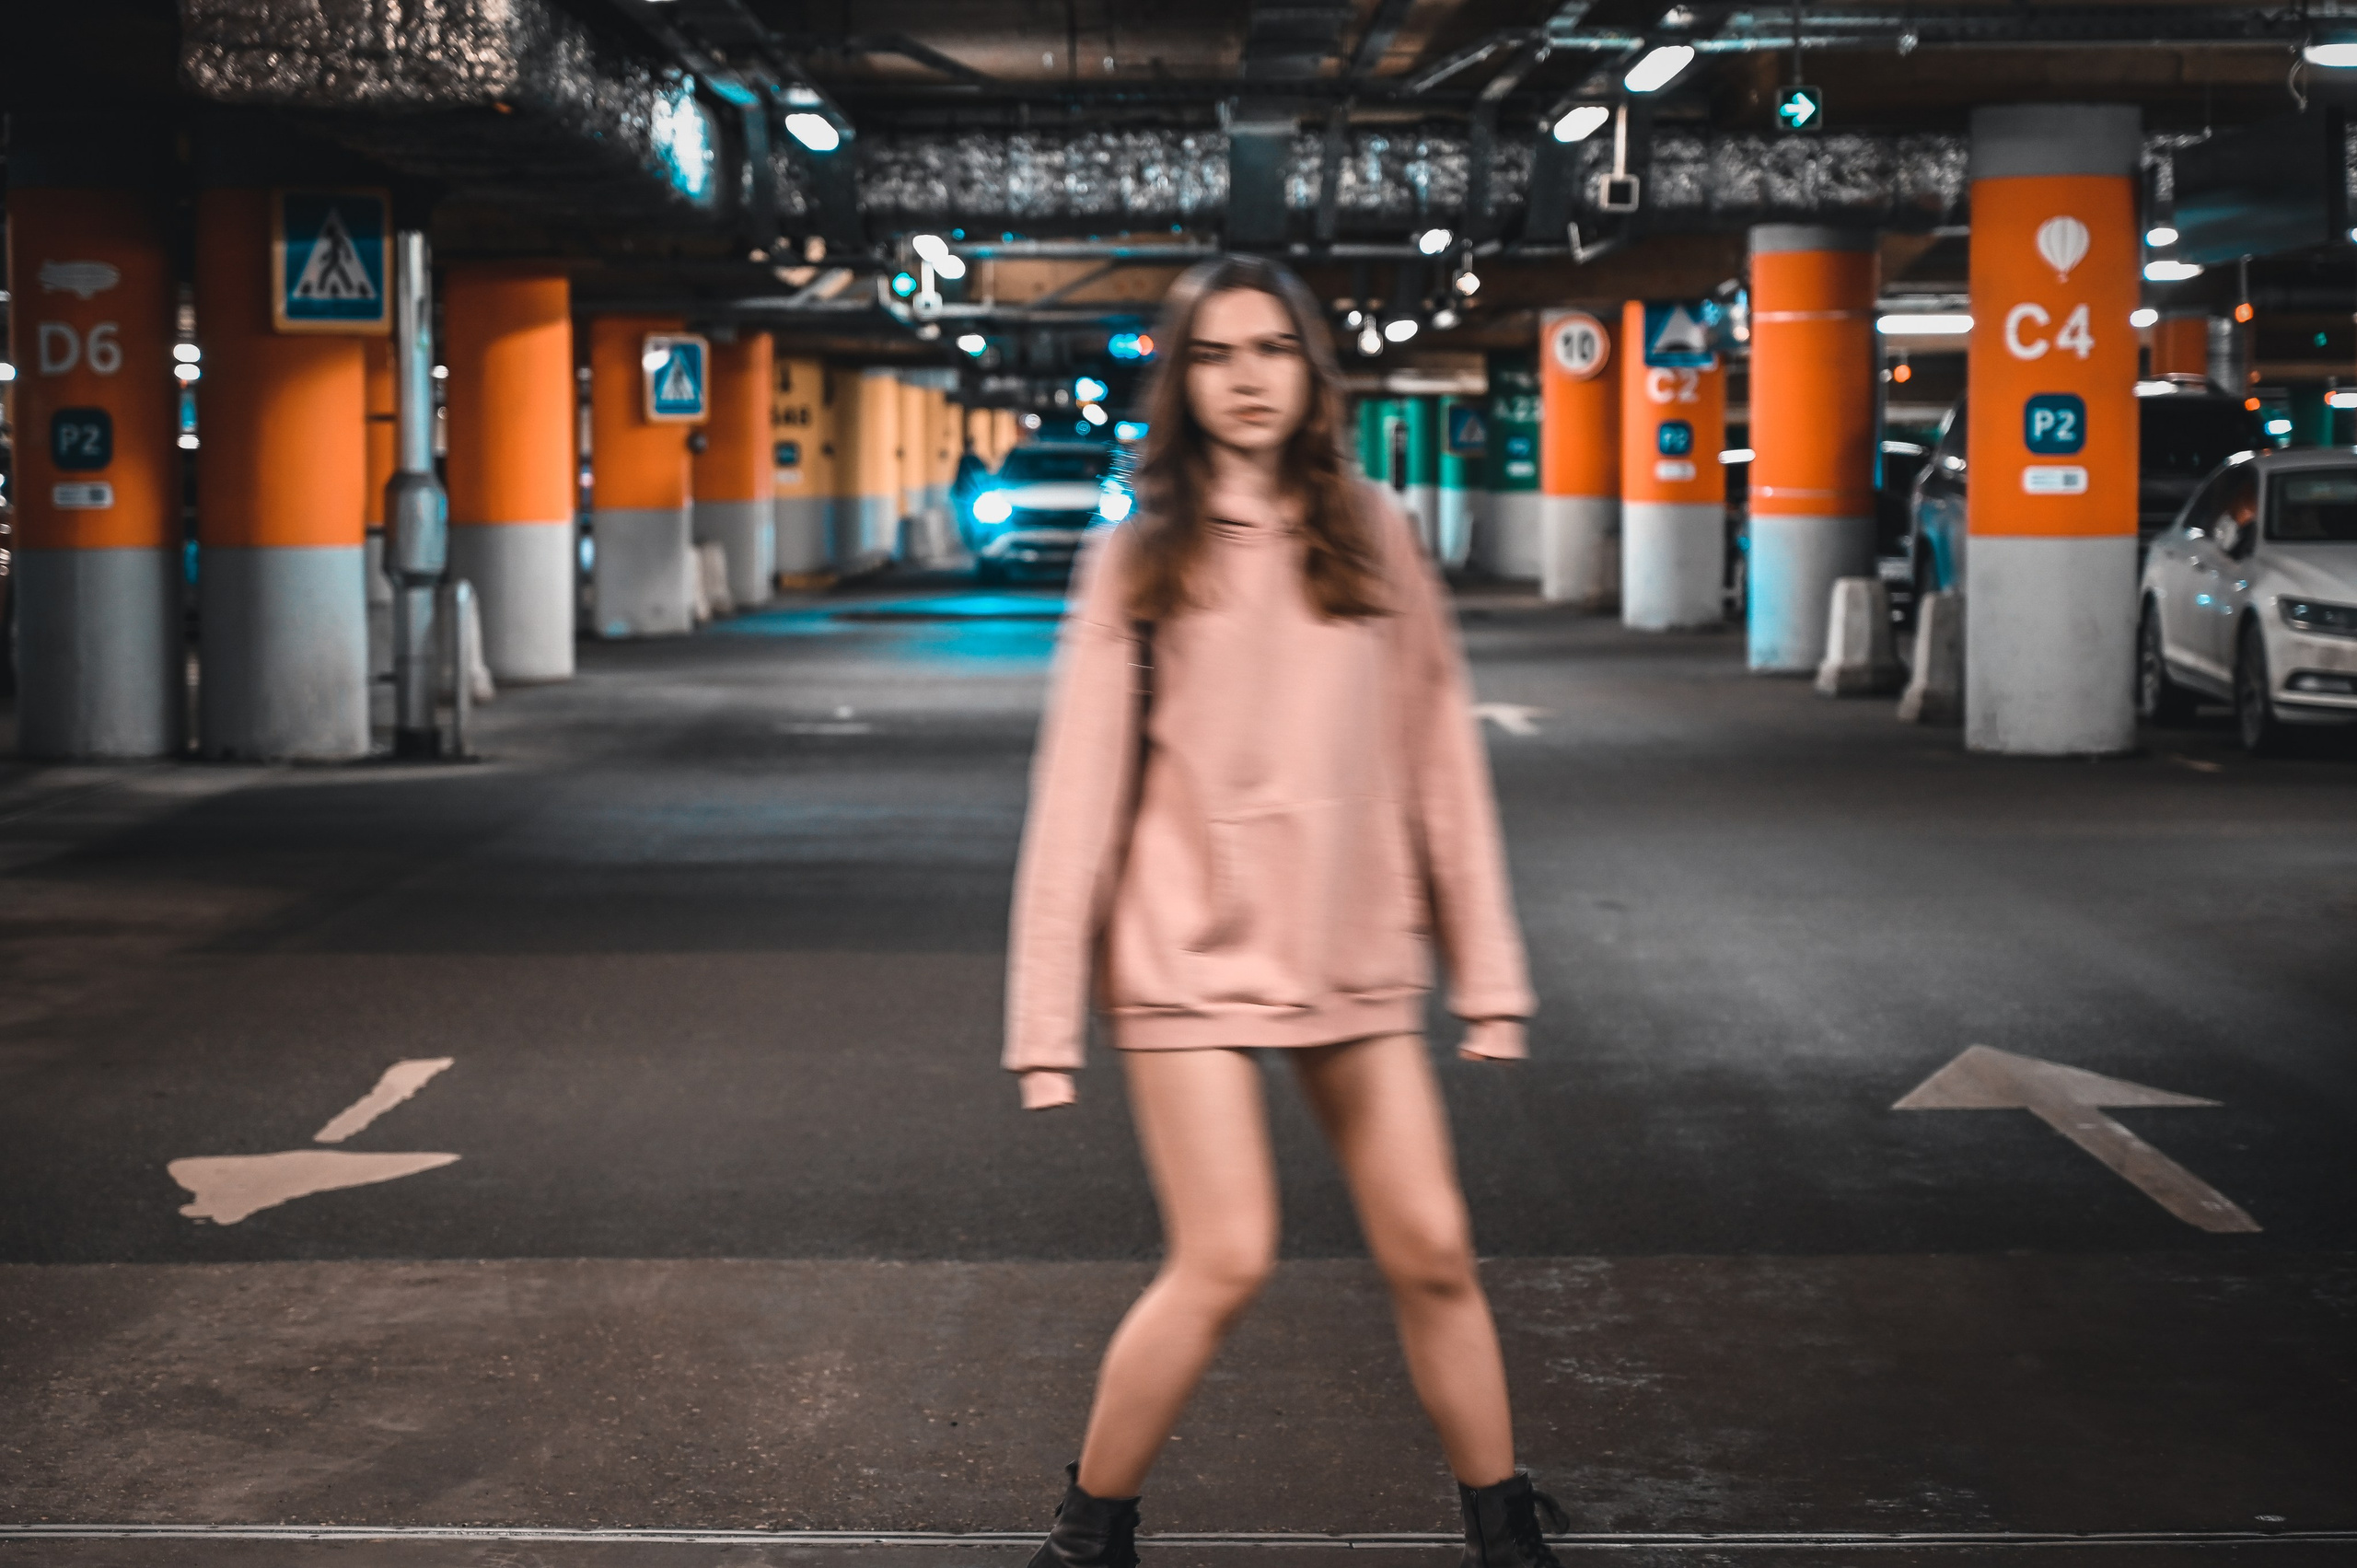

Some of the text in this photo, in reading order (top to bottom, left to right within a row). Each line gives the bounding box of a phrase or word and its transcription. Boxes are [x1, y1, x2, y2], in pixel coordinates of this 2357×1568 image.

[40, 323, 122, 373] D6
[1562, 331, 1596, 363] 10
[2004, 302, 2095, 361] C4
[1646, 367, 1700, 403] C2
[58, 423, 100, 455] P2
[2032, 407, 2077, 441] P2
